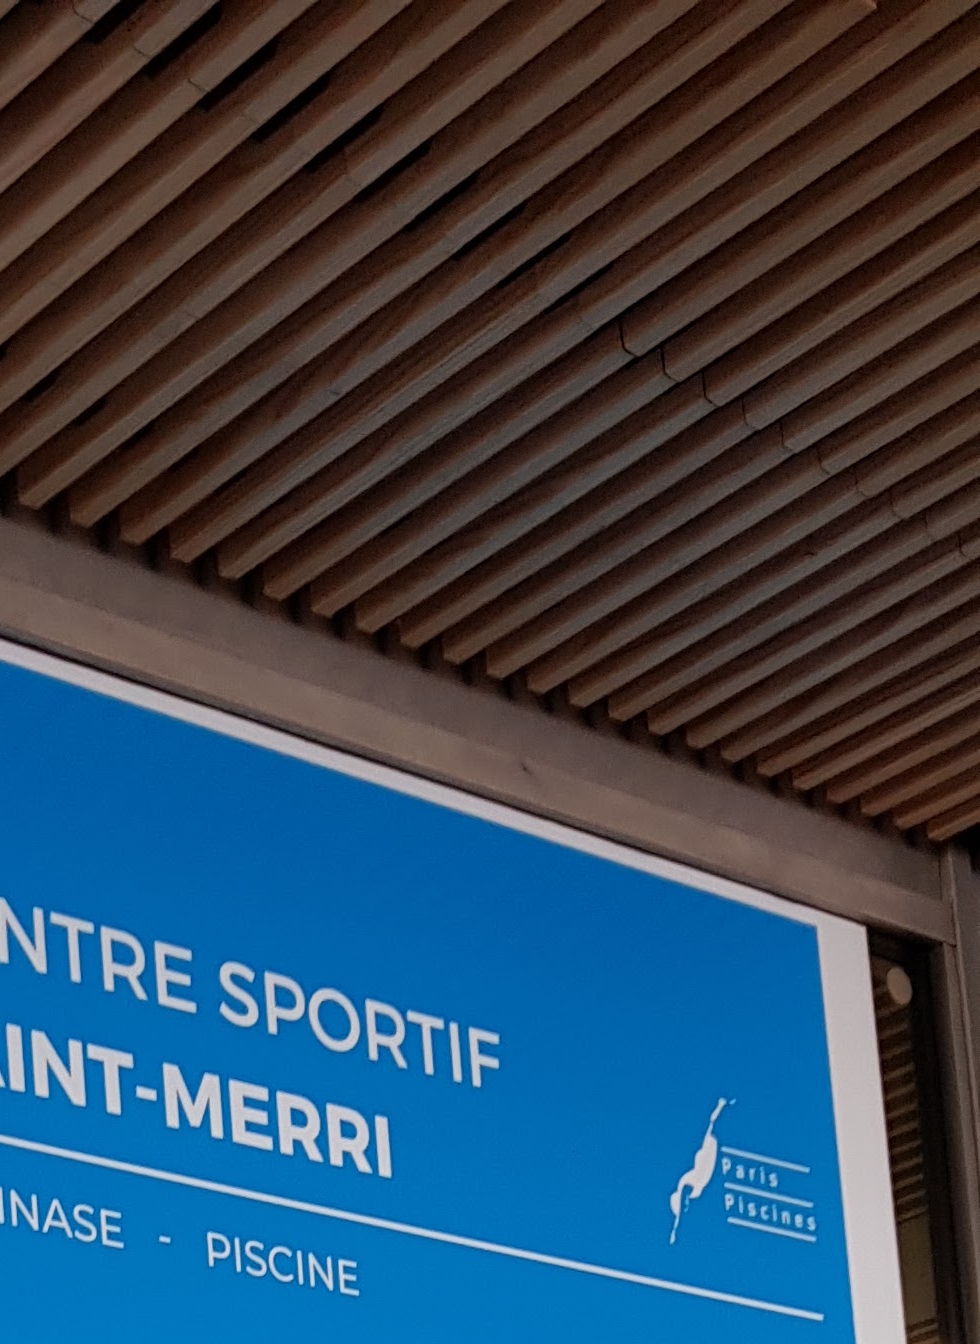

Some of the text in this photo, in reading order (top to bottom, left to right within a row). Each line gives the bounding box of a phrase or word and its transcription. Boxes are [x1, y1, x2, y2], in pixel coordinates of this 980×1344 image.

[219, 961, 501, 1088] SPORTIF
[721, 1157, 778, 1188] Paris
[724, 1193, 816, 1231] Piscines
[206, 1231, 360, 1297] PISCINE
